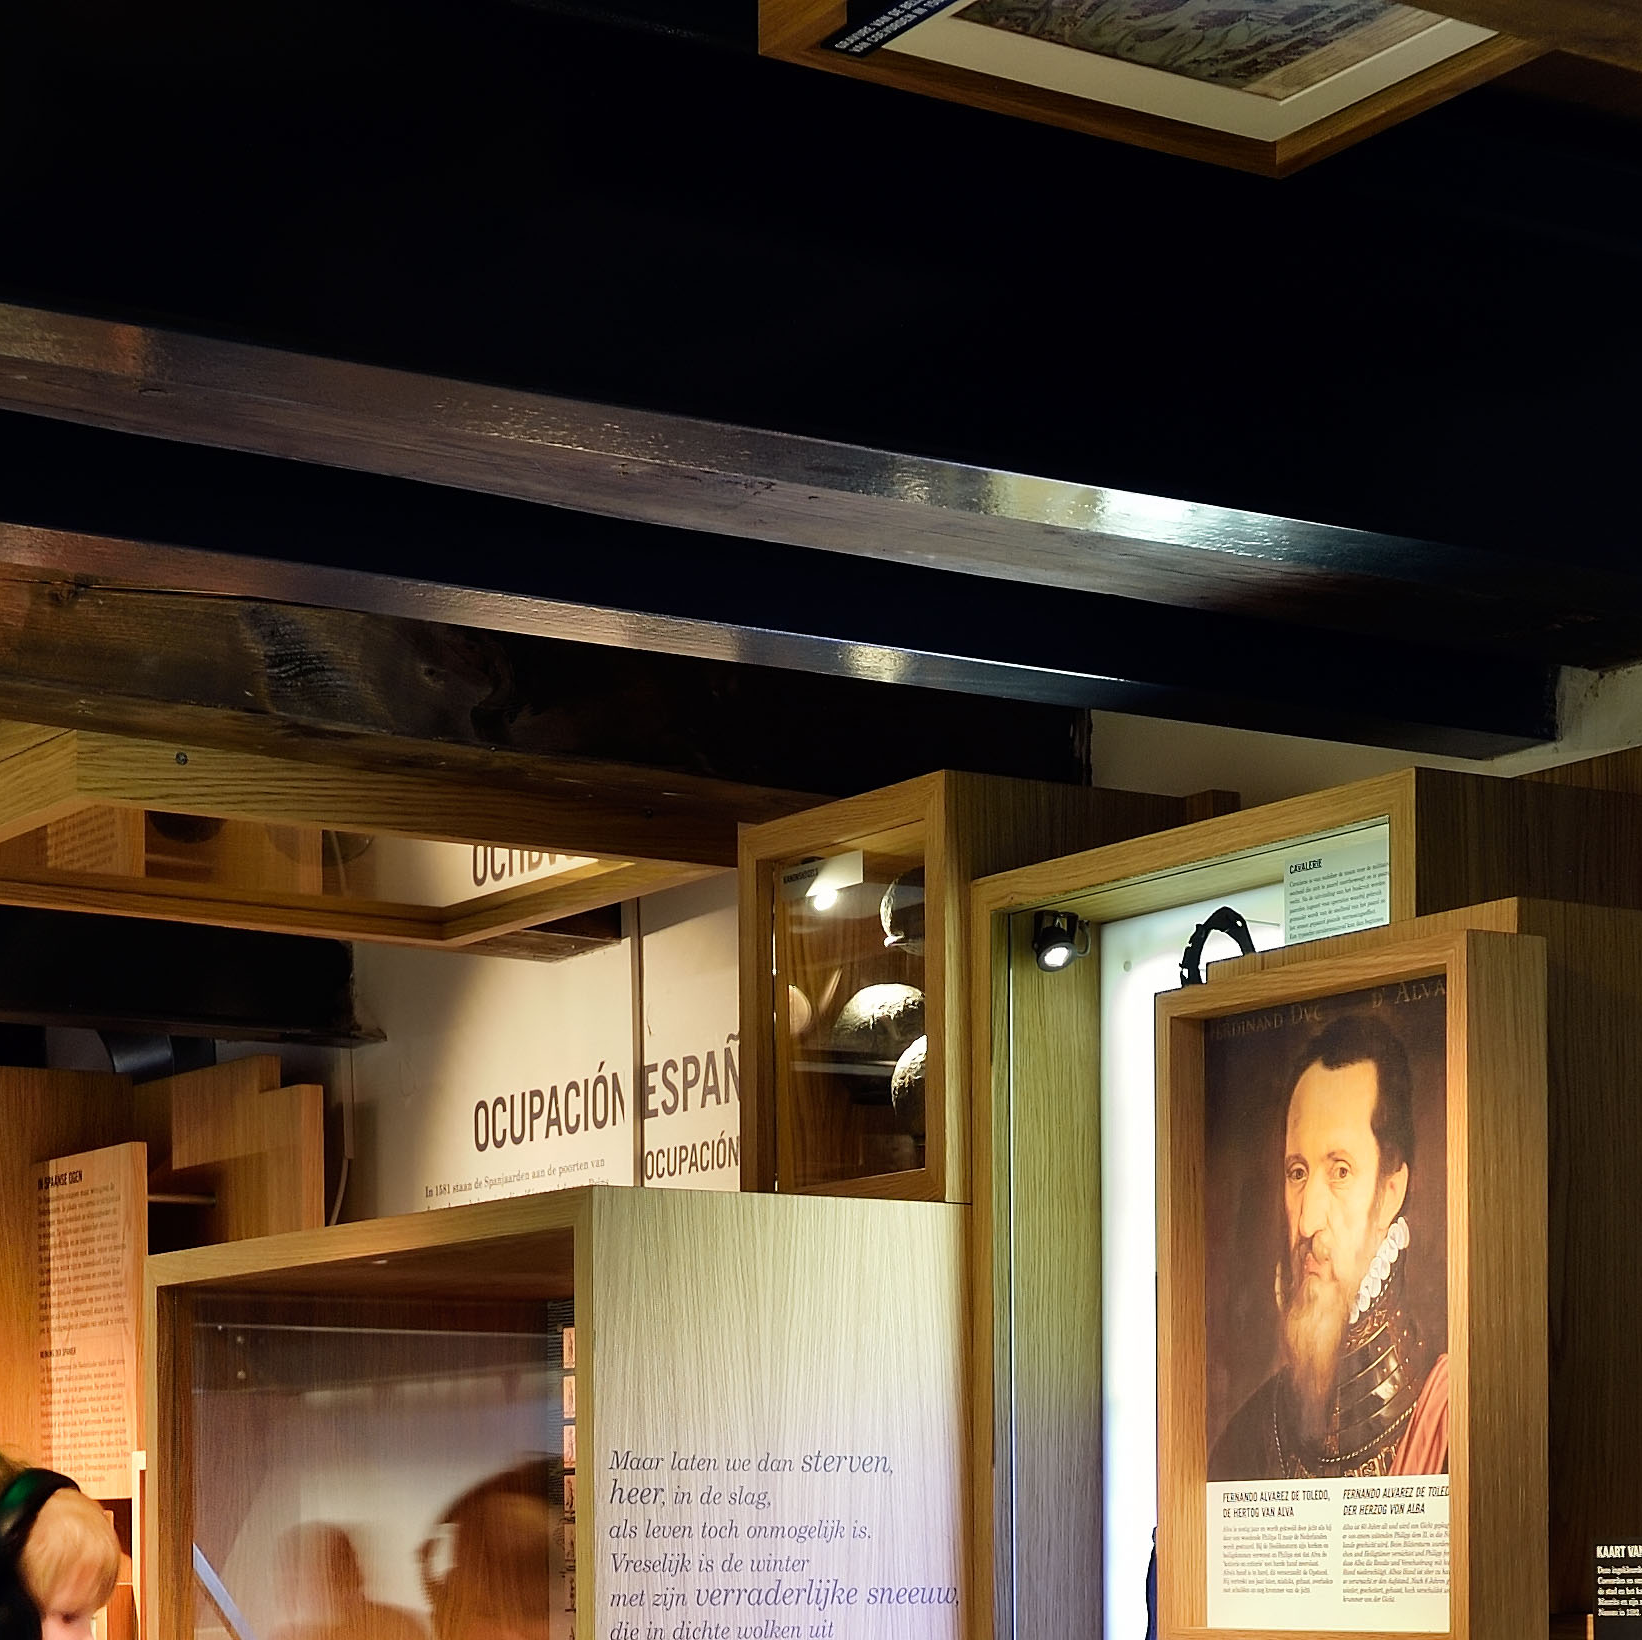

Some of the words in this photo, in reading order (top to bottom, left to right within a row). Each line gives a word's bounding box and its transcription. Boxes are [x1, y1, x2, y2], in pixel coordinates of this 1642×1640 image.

[474, 1061, 625, 1152] OCUPACIÓN
[644, 1033, 740, 1120] ESPAÑ
[645, 1130, 739, 1180] OCUPACIÓN
[425, 1185, 433, 1198] In
[435, 1183, 450, 1197] 1581
[452, 1182, 472, 1194] staan
[474, 1177, 483, 1189] de
[484, 1169, 529, 1190] Spanjaarden
[532, 1166, 545, 1178] aan
[547, 1164, 557, 1176] de
[558, 1159, 589, 1178] poorten
[591, 1157, 605, 1169] van
[609, 1450, 664, 1471] Maar
[671, 1451, 718, 1472] laten
[726, 1457, 751, 1472] we
[757, 1452, 793, 1472] dan
[801, 1450, 893, 1475] sterven,
[610, 1479, 665, 1507] heer,
[674, 1486, 692, 1505] in
[700, 1485, 722, 1505] de
[729, 1486, 771, 1510] slag,
[1222, 1492, 1258, 1503] FERNANDO
[1259, 1491, 1289, 1502] ALVAREZ
[1291, 1490, 1300, 1501] DE
[1302, 1489, 1331, 1501] TOLEDO,
[1342, 1488, 1381, 1500] FERNANDO
[1382, 1487, 1414, 1498] ALVAREZ
[1415, 1486, 1426, 1497] DE
[1222, 1507, 1232, 1518] DE
[1233, 1507, 1260, 1518] HERTOG
[1261, 1507, 1275, 1518] VAN
[1277, 1506, 1295, 1518] ALVA
[1343, 1505, 1357, 1516] DER
[1358, 1504, 1388, 1516] HERZOG
[1389, 1503, 1405, 1515] VON
[1406, 1503, 1425, 1514] ALBA
[609, 1519, 637, 1539] als
[645, 1519, 693, 1539] leven
[701, 1519, 739, 1539] toch
[746, 1520, 846, 1544] onmogelijk
[852, 1520, 872, 1539] is.
[1596, 1545, 1626, 1559] KAART
[611, 1553, 691, 1577] Vreselijk
[699, 1554, 714, 1573] is
[721, 1553, 743, 1573] de
[750, 1553, 809, 1573] winter
[610, 1590, 646, 1607] met
[652, 1587, 687, 1611] zijn
[696, 1578, 858, 1611] verraderlijke
[867, 1585, 960, 1607] sneeuw,
[646, 1621, 665, 1640] in
[672, 1620, 731, 1640] dichte
[737, 1619, 802, 1640] wolken
[809, 1619, 834, 1639] uit
